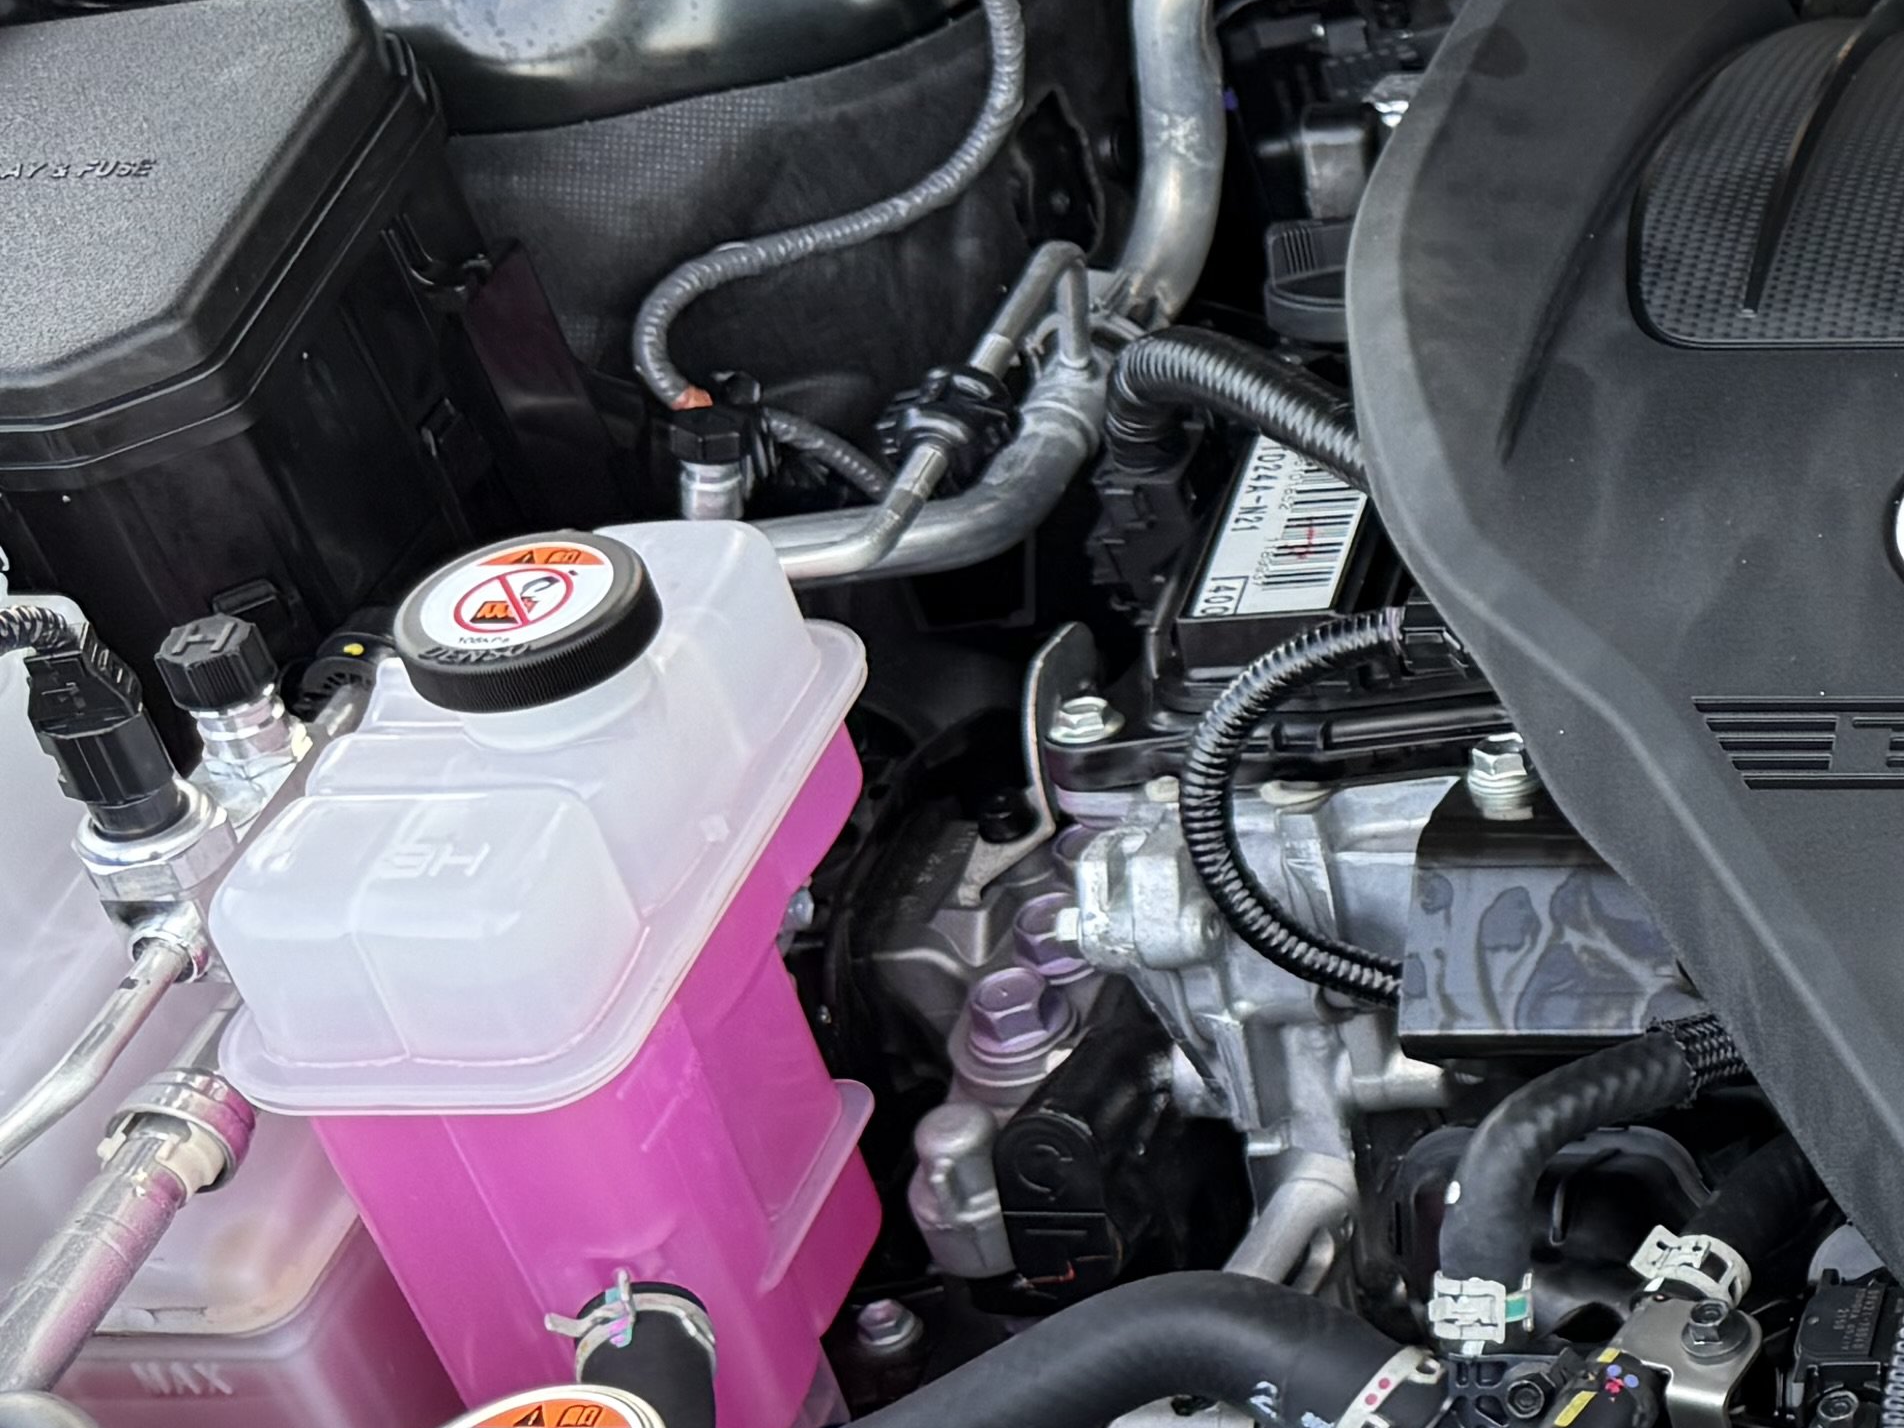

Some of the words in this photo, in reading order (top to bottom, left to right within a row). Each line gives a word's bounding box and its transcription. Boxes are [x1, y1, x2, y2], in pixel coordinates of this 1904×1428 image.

[75, 160, 157, 179] FUSE
[418, 643, 532, 665] DENSO
[132, 1359, 233, 1396] MAX
